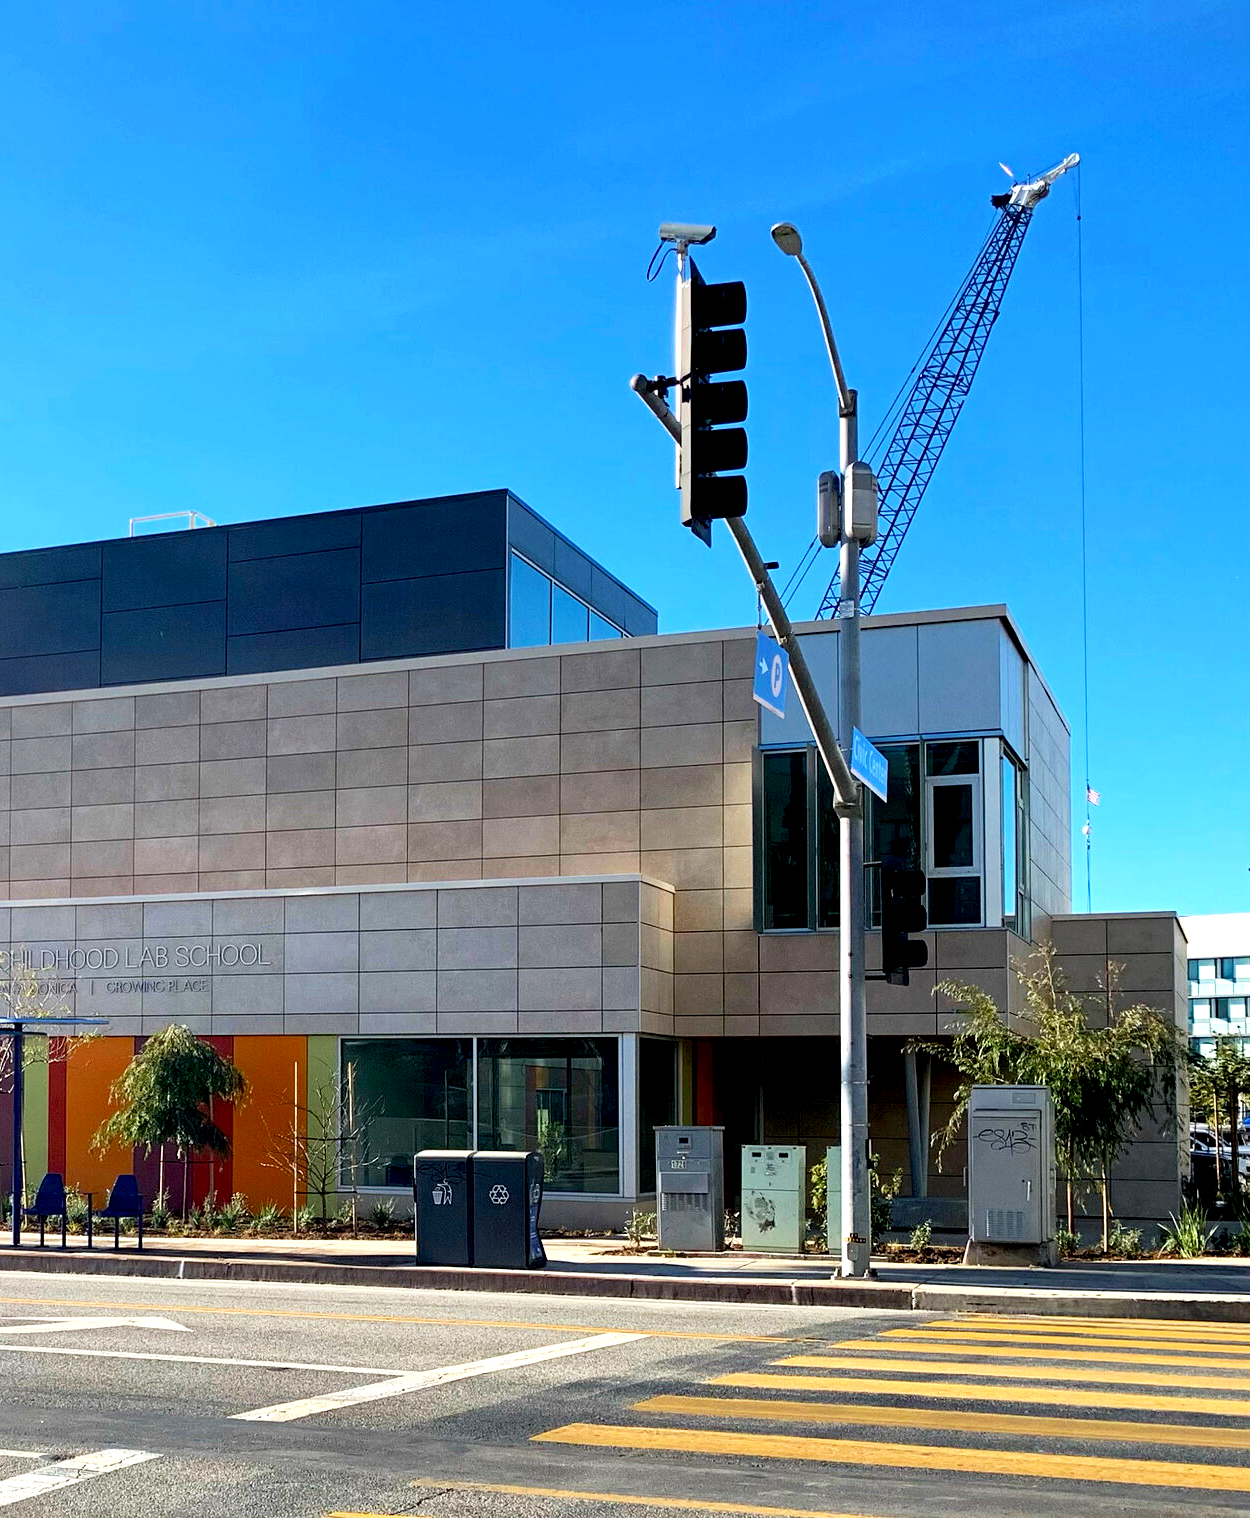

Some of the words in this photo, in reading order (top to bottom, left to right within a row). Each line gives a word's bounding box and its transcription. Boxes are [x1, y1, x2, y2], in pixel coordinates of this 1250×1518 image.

[854, 735, 868, 769] Civic
[124, 945, 169, 969] LAB
[174, 943, 272, 967] SCHOOL
[168, 979, 209, 993] PLACE
